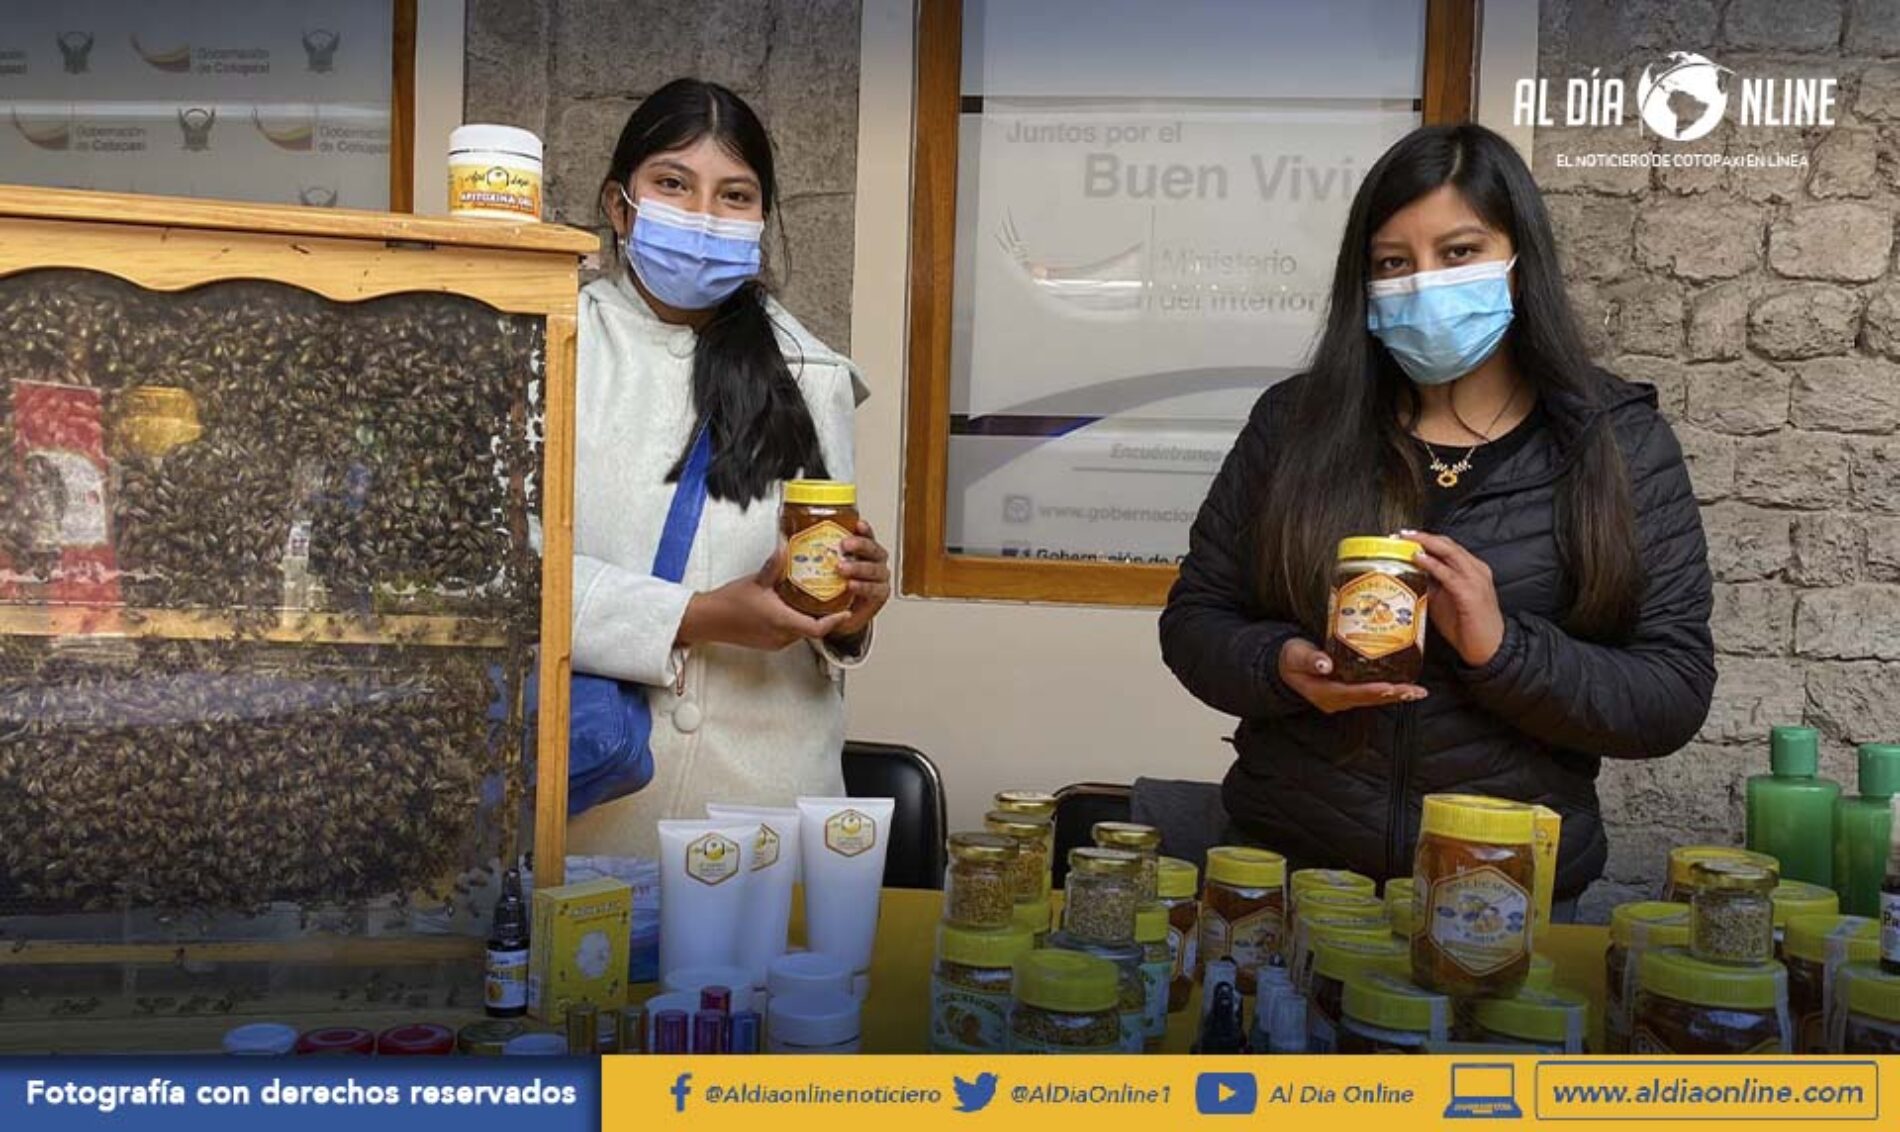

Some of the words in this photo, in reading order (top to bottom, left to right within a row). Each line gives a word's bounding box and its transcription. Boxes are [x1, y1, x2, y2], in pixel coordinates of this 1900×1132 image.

[1005, 120, 1096, 144] Juntos
[1105, 124, 1151, 149] por
[1158, 120, 1183, 143] el
[1083, 153, 1229, 200] Buen
[1160, 247, 1298, 276] Ministerio
